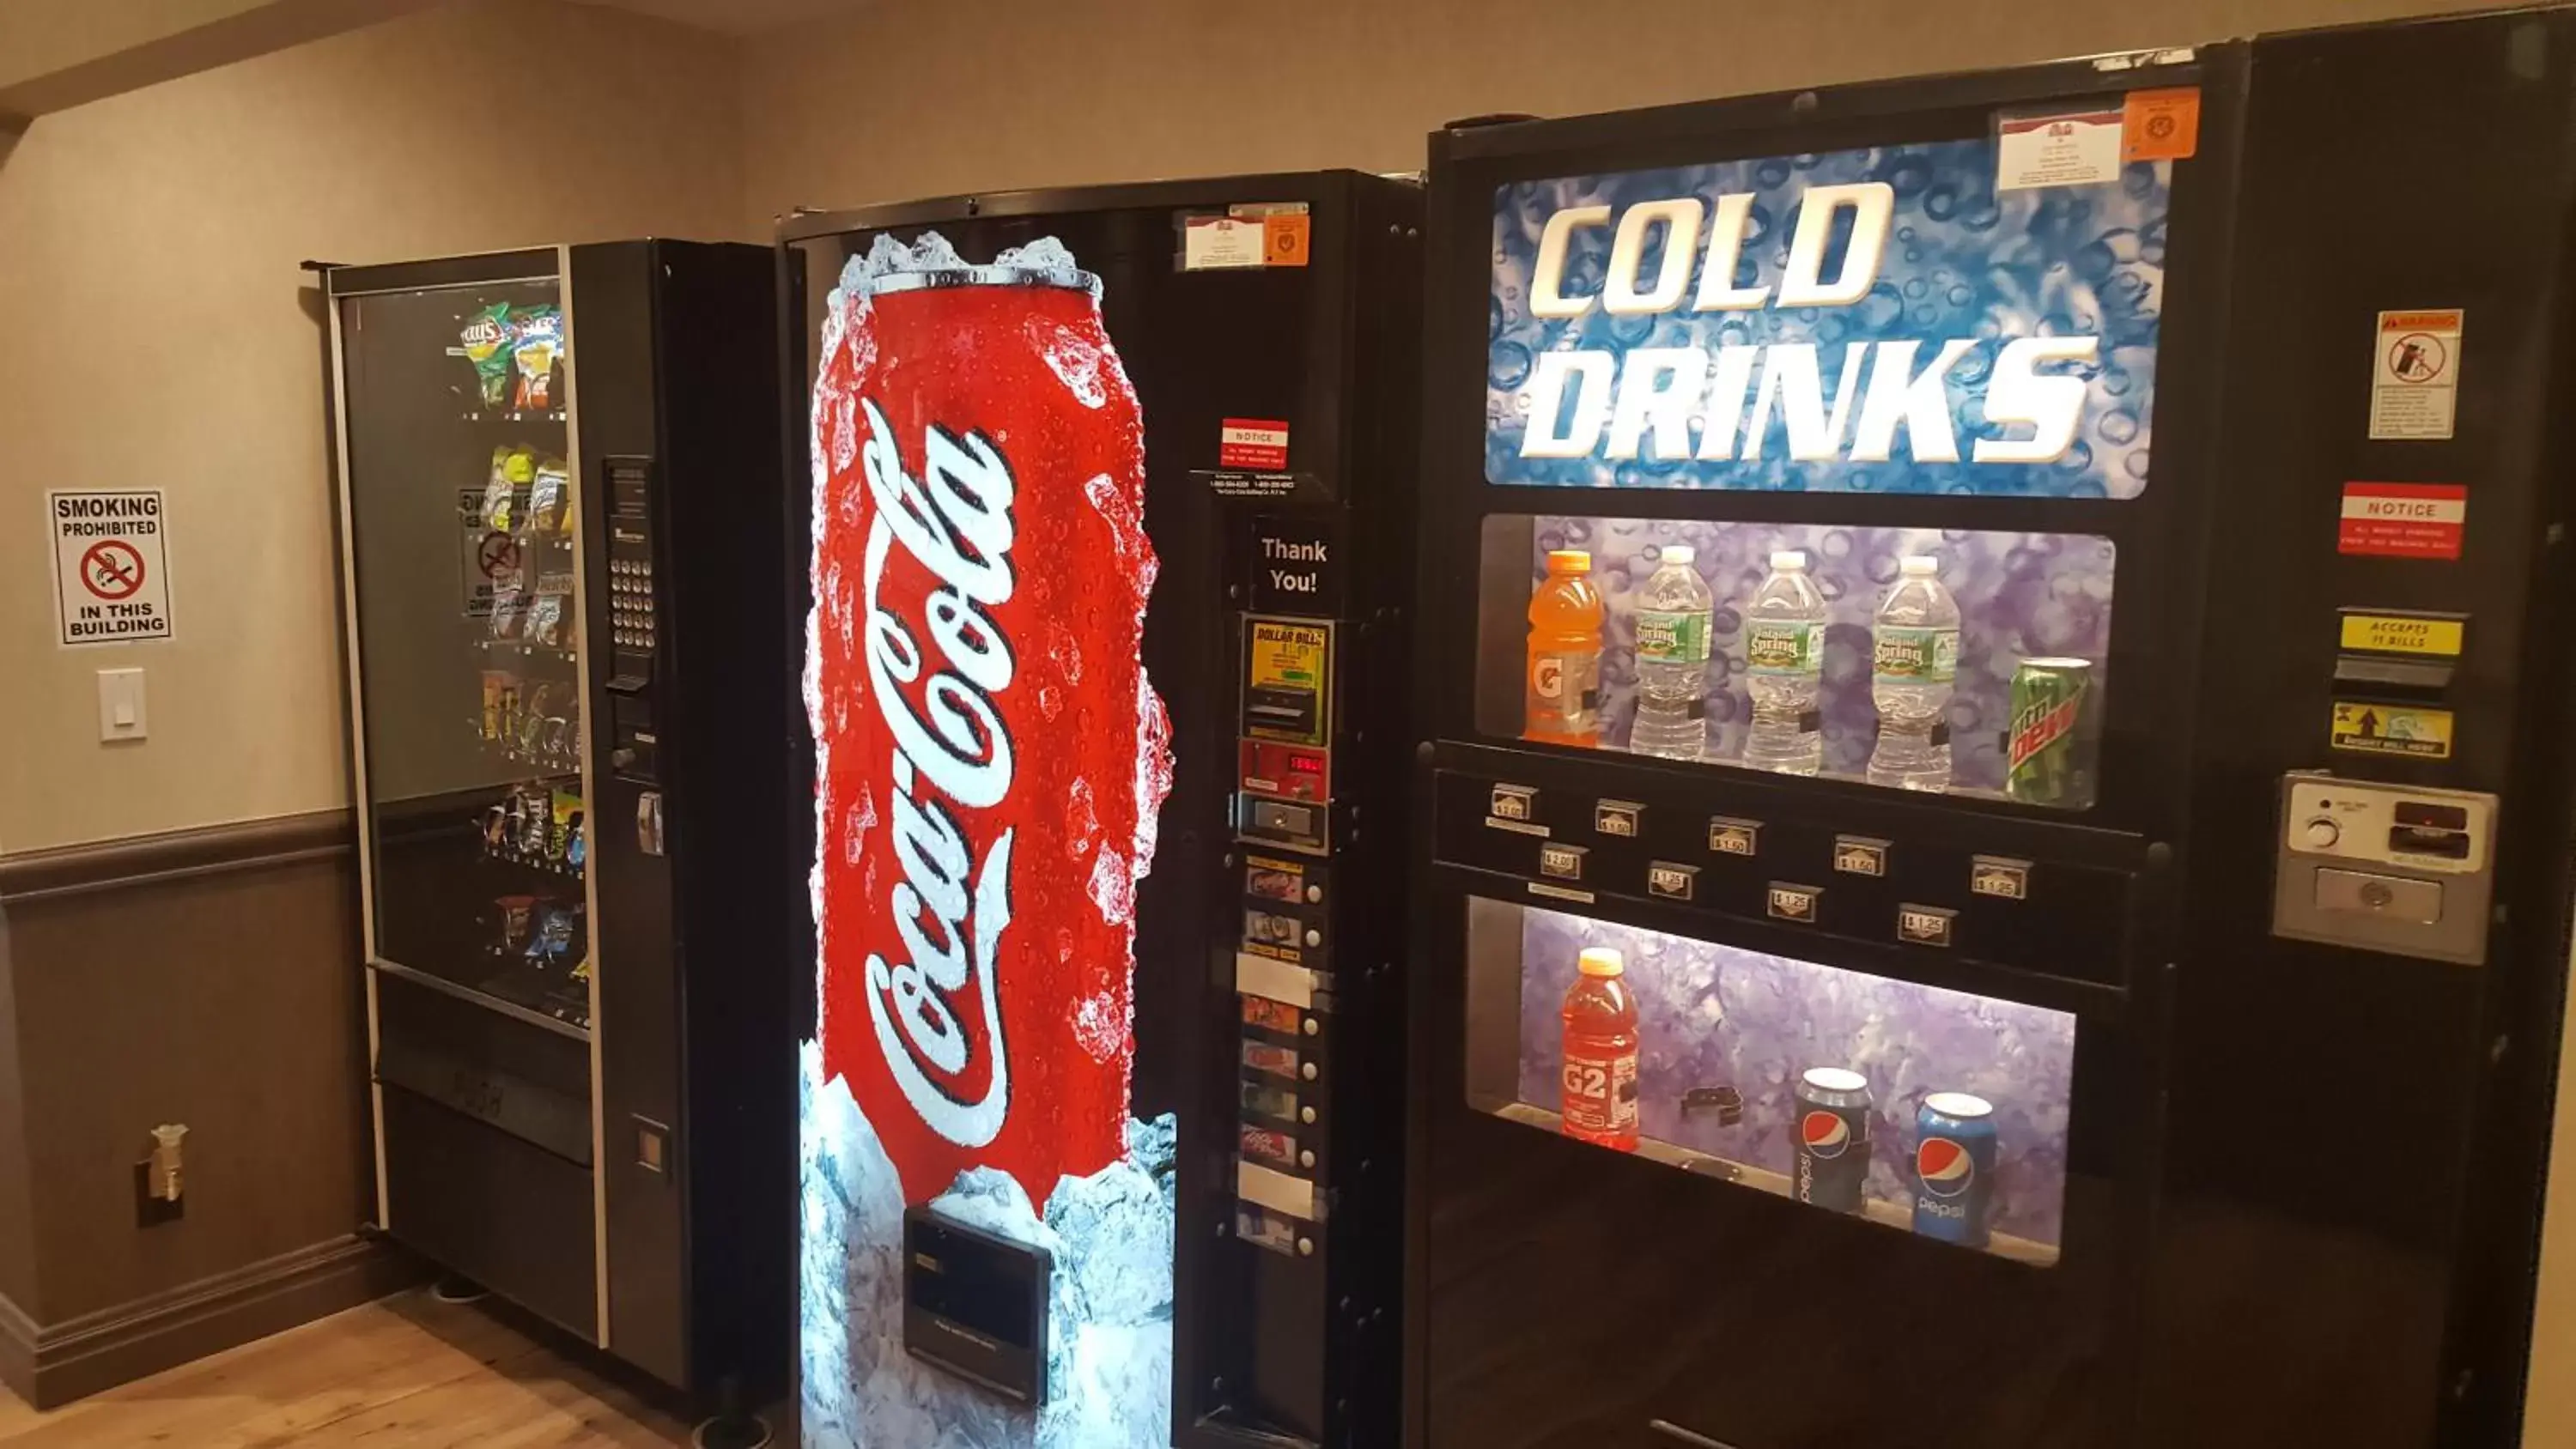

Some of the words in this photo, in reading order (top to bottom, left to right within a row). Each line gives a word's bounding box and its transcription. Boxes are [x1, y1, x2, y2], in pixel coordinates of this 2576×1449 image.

[1529, 181, 1894, 318] COLD
[1519, 336, 2099, 463] DRINKS
[1236, 432, 1273, 442] NOTICE
[58, 498, 158, 518] SMOKING
[2367, 501, 2437, 517] NOTICE
[63, 521, 156, 537] PROHIBITED
[1261, 537, 1327, 562] Thank
[1270, 569, 1317, 592] You!
[80, 606, 100, 619] IN
[106, 603, 153, 617] THIS
[70, 617, 164, 636] BUILDING
[1257, 627, 1293, 641] DOLLAR
[2370, 621, 2429, 636] ACCEPTS
[1751, 638, 1797, 658] Spring
[1874, 646, 1923, 667] Spring
[1534, 658, 1562, 698] G
[861, 397, 1015, 1147] Coca-Cola
[1563, 1064, 1607, 1099] G2
[1800, 1153, 1814, 1203] pepsi
[1919, 1197, 1965, 1218] pepsi
